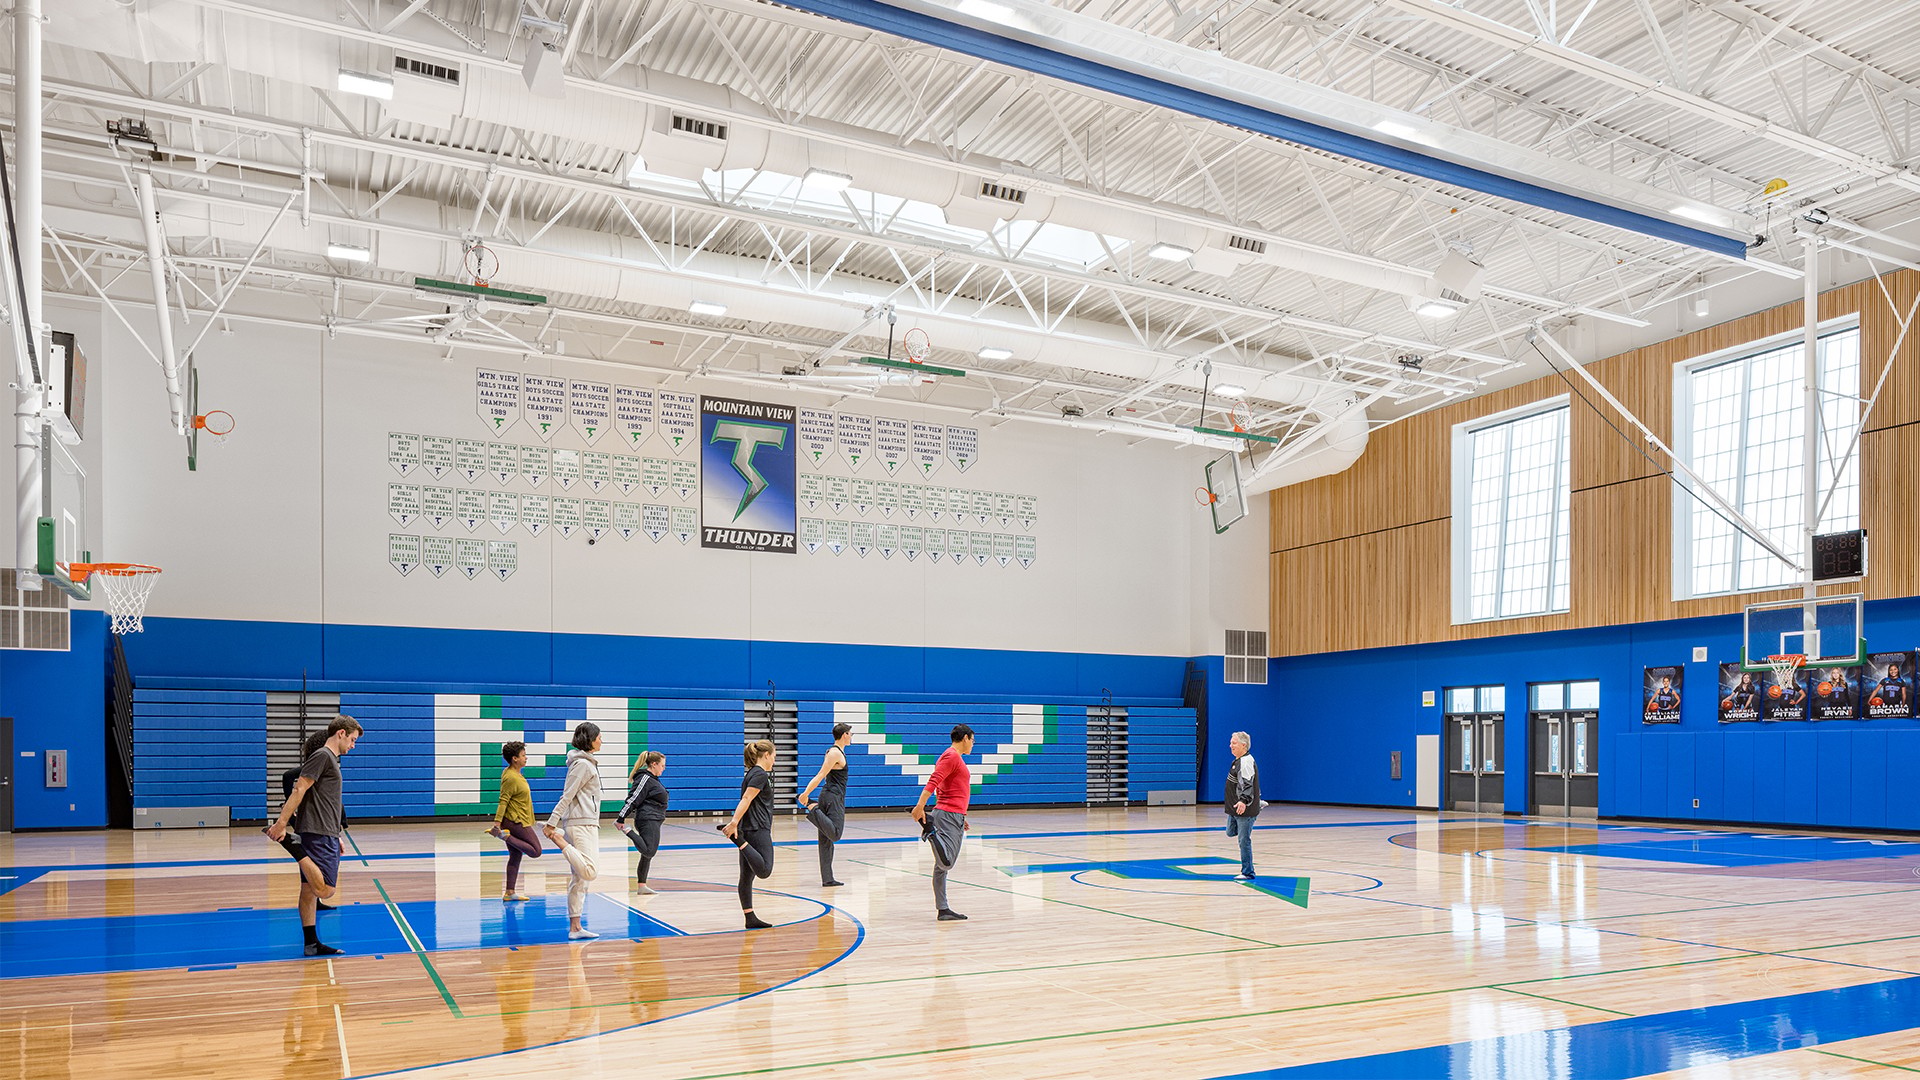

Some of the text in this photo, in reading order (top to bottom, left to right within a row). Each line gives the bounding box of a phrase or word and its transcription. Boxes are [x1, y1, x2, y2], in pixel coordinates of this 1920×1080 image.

[479, 372, 518, 383] MTN. VIEW
[498, 383, 519, 391] TRACK
[546, 380, 564, 388] VIEW
[572, 383, 609, 393] MTN. VIEW
[616, 388, 634, 396] MTN.
[480, 398, 517, 407] CHAMPIONS
[527, 404, 563, 413] CHAMPIONS
[663, 403, 692, 411] SOFTBALL
[703, 400, 794, 420] MOUNTAIN VIEW
[572, 409, 608, 417] CHAMPIONS
[617, 414, 652, 422] CHAMPIONS
[660, 419, 694, 427] CHAMPIONS
[802, 434, 832, 442] CHAMPIONS
[878, 444, 906, 452] CHAMPIONS
[914, 447, 941, 455] CHAMPIONS
[704, 528, 795, 548] THUNDER
[435, 694, 1050, 809] M V
